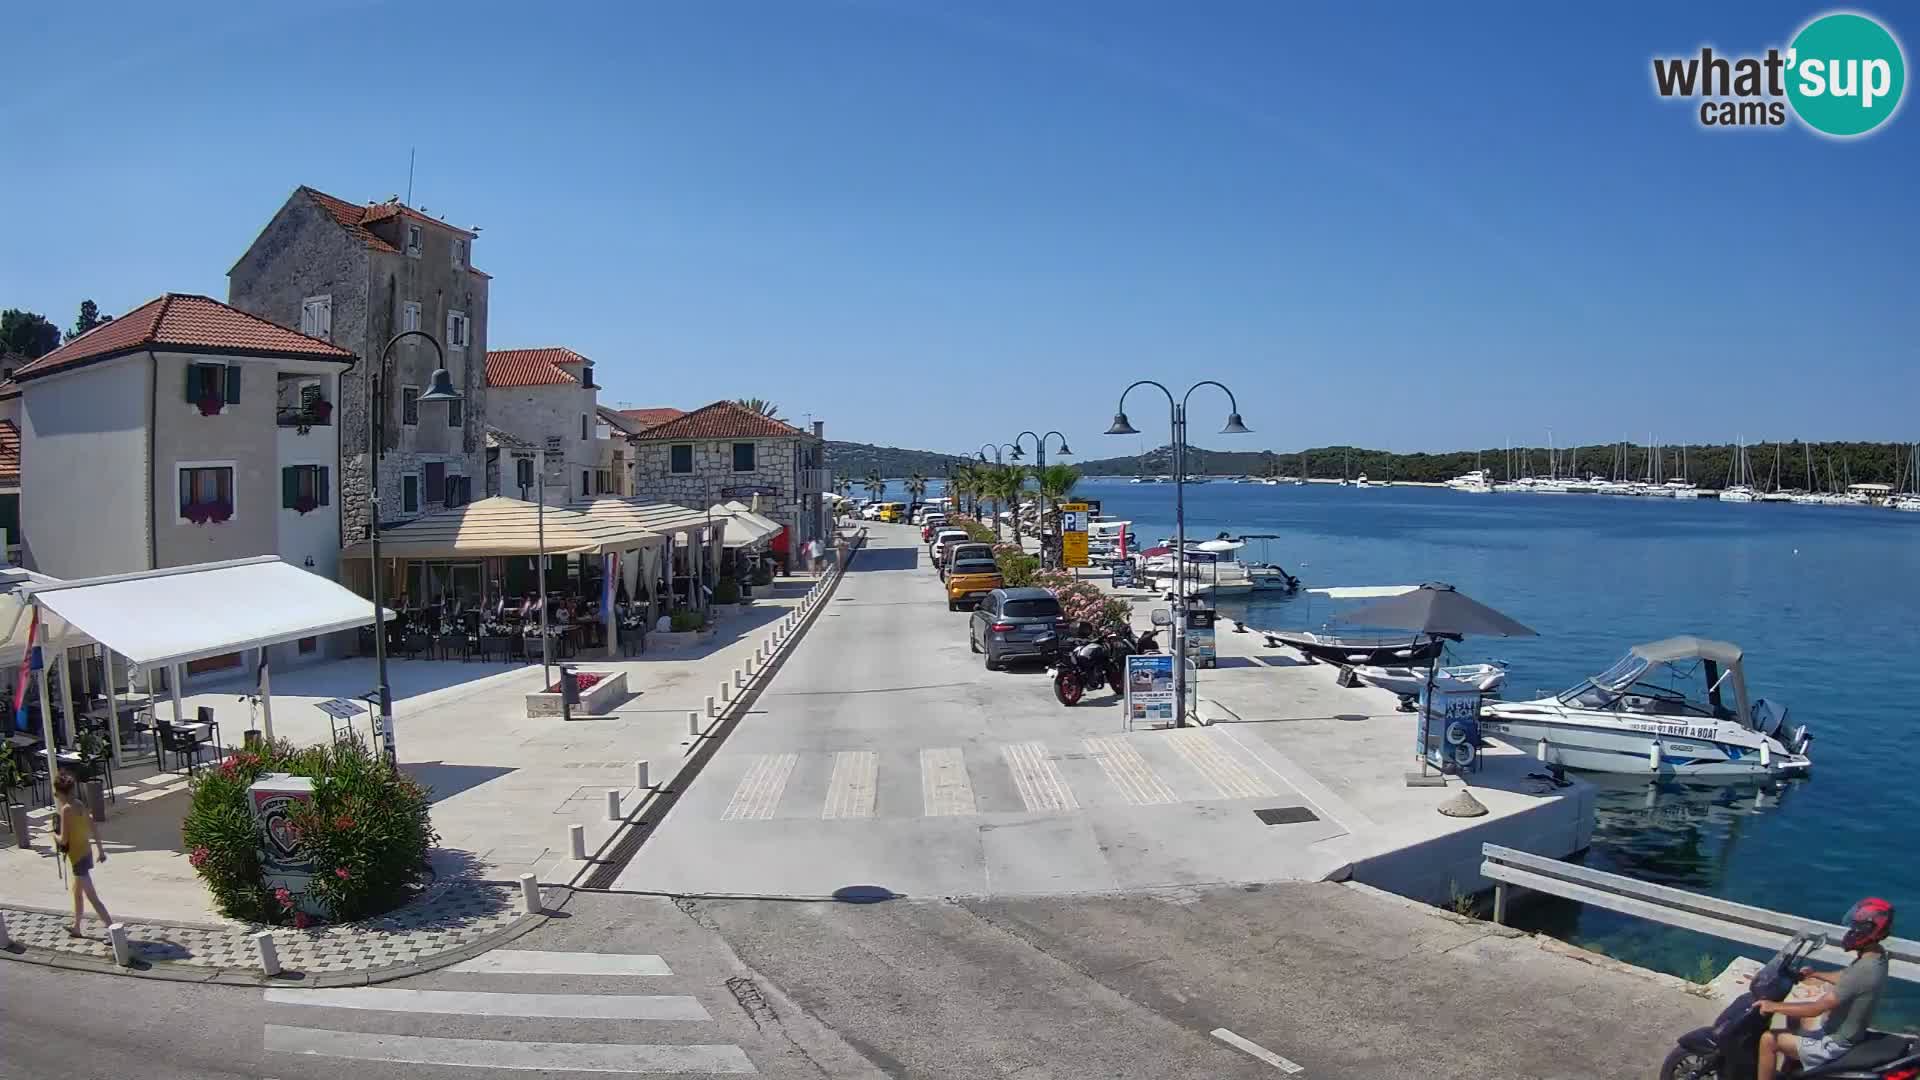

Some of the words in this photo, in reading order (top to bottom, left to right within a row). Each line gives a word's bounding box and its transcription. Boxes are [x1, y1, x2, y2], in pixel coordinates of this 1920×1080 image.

[1064, 513, 1075, 529] P
[1447, 696, 1479, 711] RENT
[1667, 725, 1688, 736] RENT
[1690, 728, 1696, 737] A
[1697, 728, 1719, 740] BOAT
